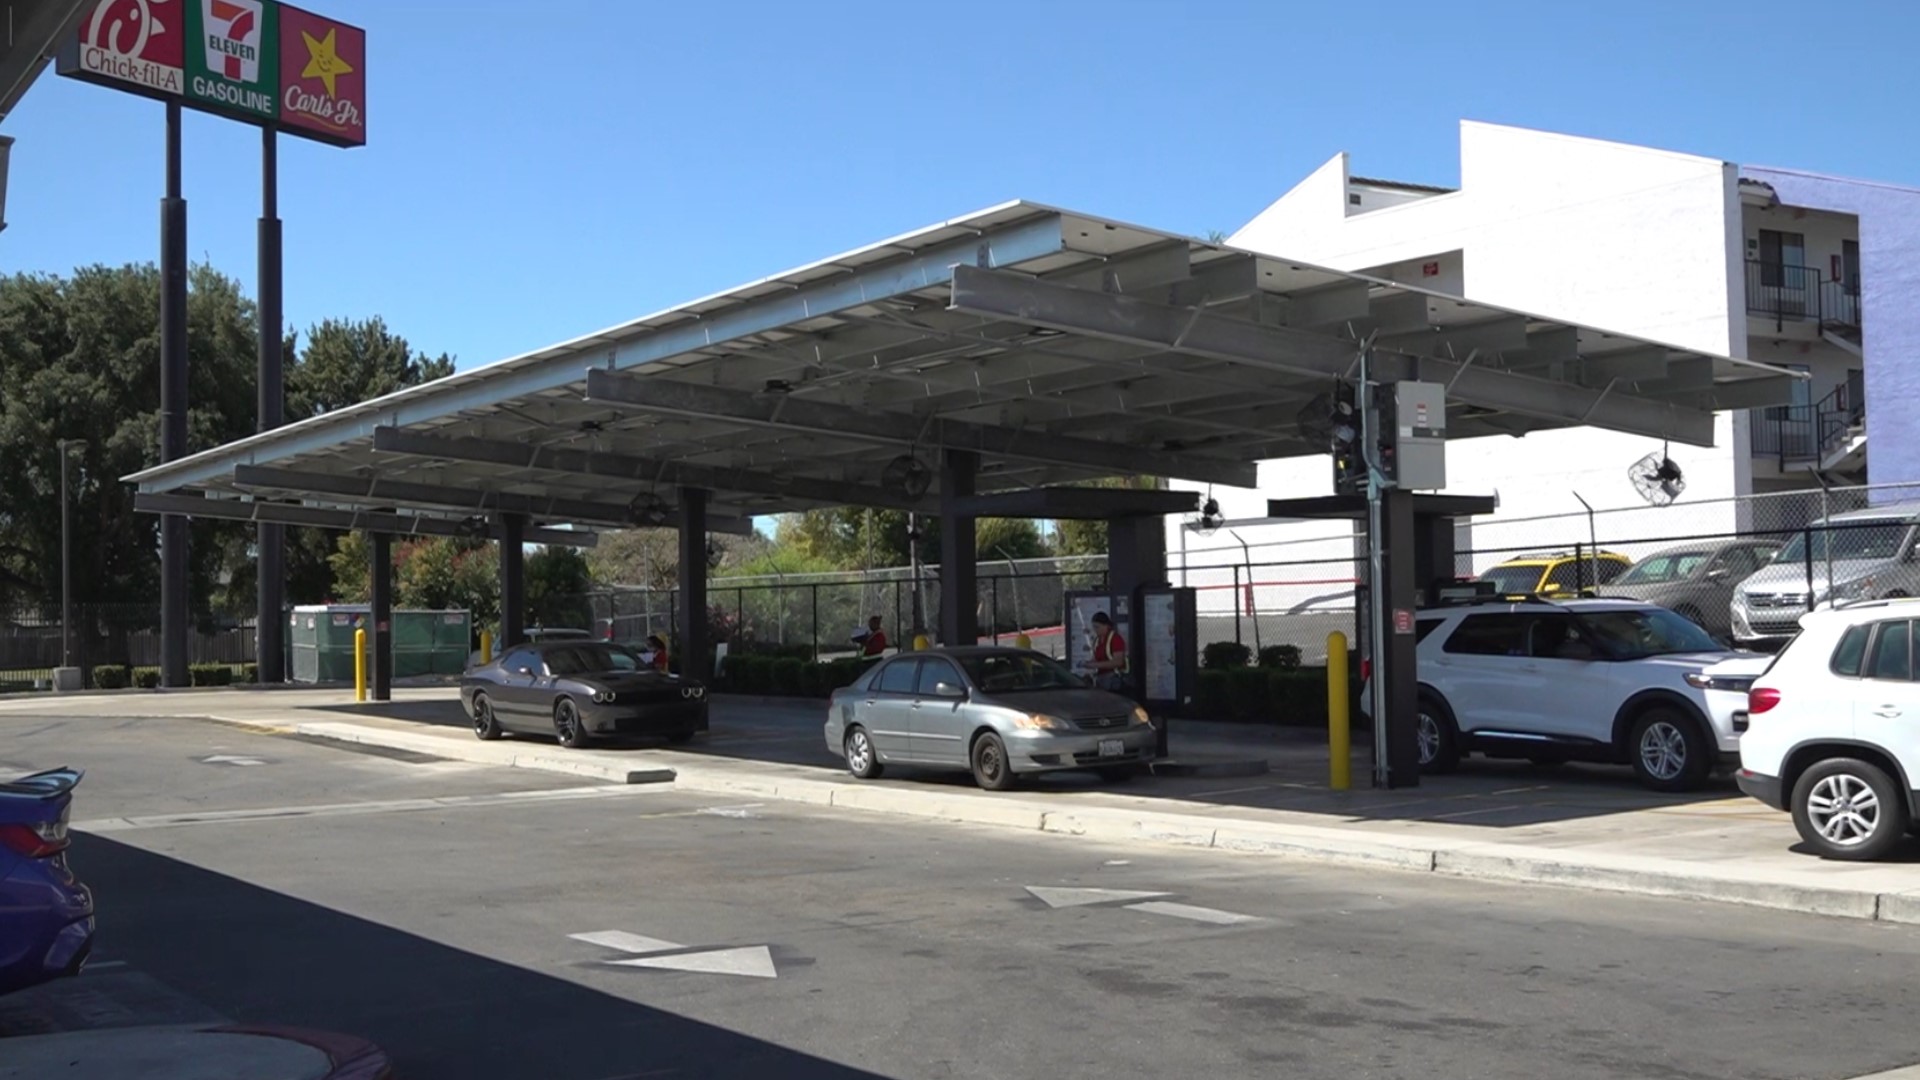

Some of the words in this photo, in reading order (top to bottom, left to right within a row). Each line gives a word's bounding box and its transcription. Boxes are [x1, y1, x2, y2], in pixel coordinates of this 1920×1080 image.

[211, 0, 254, 81] 7
[86, 47, 179, 91] Chick-fil-A
[193, 76, 272, 113] GASOLINE
[285, 85, 334, 118] Carl's
[334, 99, 362, 126] Jr.
